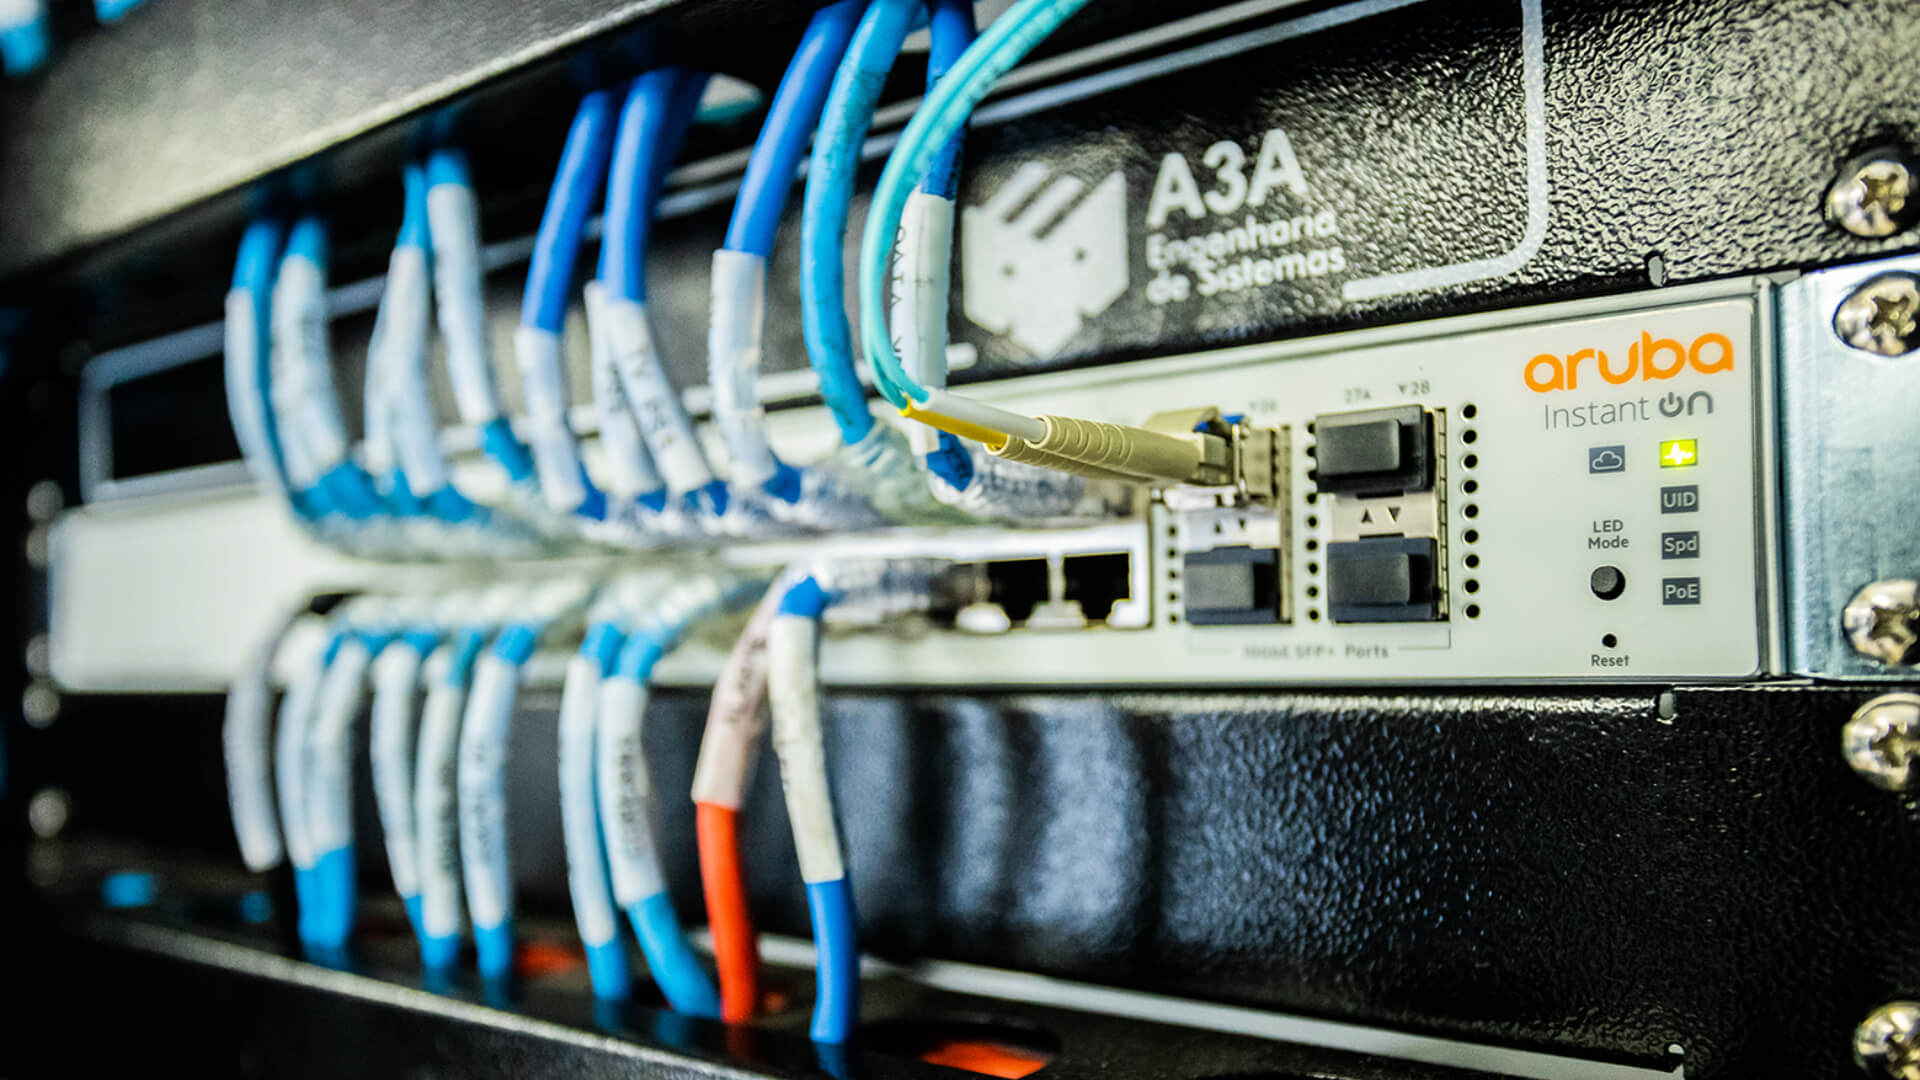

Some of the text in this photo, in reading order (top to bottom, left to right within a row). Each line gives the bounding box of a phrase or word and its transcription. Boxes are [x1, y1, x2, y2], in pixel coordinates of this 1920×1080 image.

[1146, 128, 1309, 229] A3A
[1146, 206, 1338, 272] Engenharia
[1146, 246, 1346, 304] de Sistemas
[1523, 330, 1735, 393] aruba
[1411, 380, 1430, 396] 28
[1544, 396, 1651, 430] Instant
[1663, 491, 1697, 508] UID
[1592, 519, 1624, 534] LED
[1587, 535, 1630, 550] Mode
[1664, 536, 1697, 555] Spd
[1665, 583, 1698, 600] PoE
[1345, 644, 1389, 659] Ports
[1591, 653, 1630, 667] Reset
